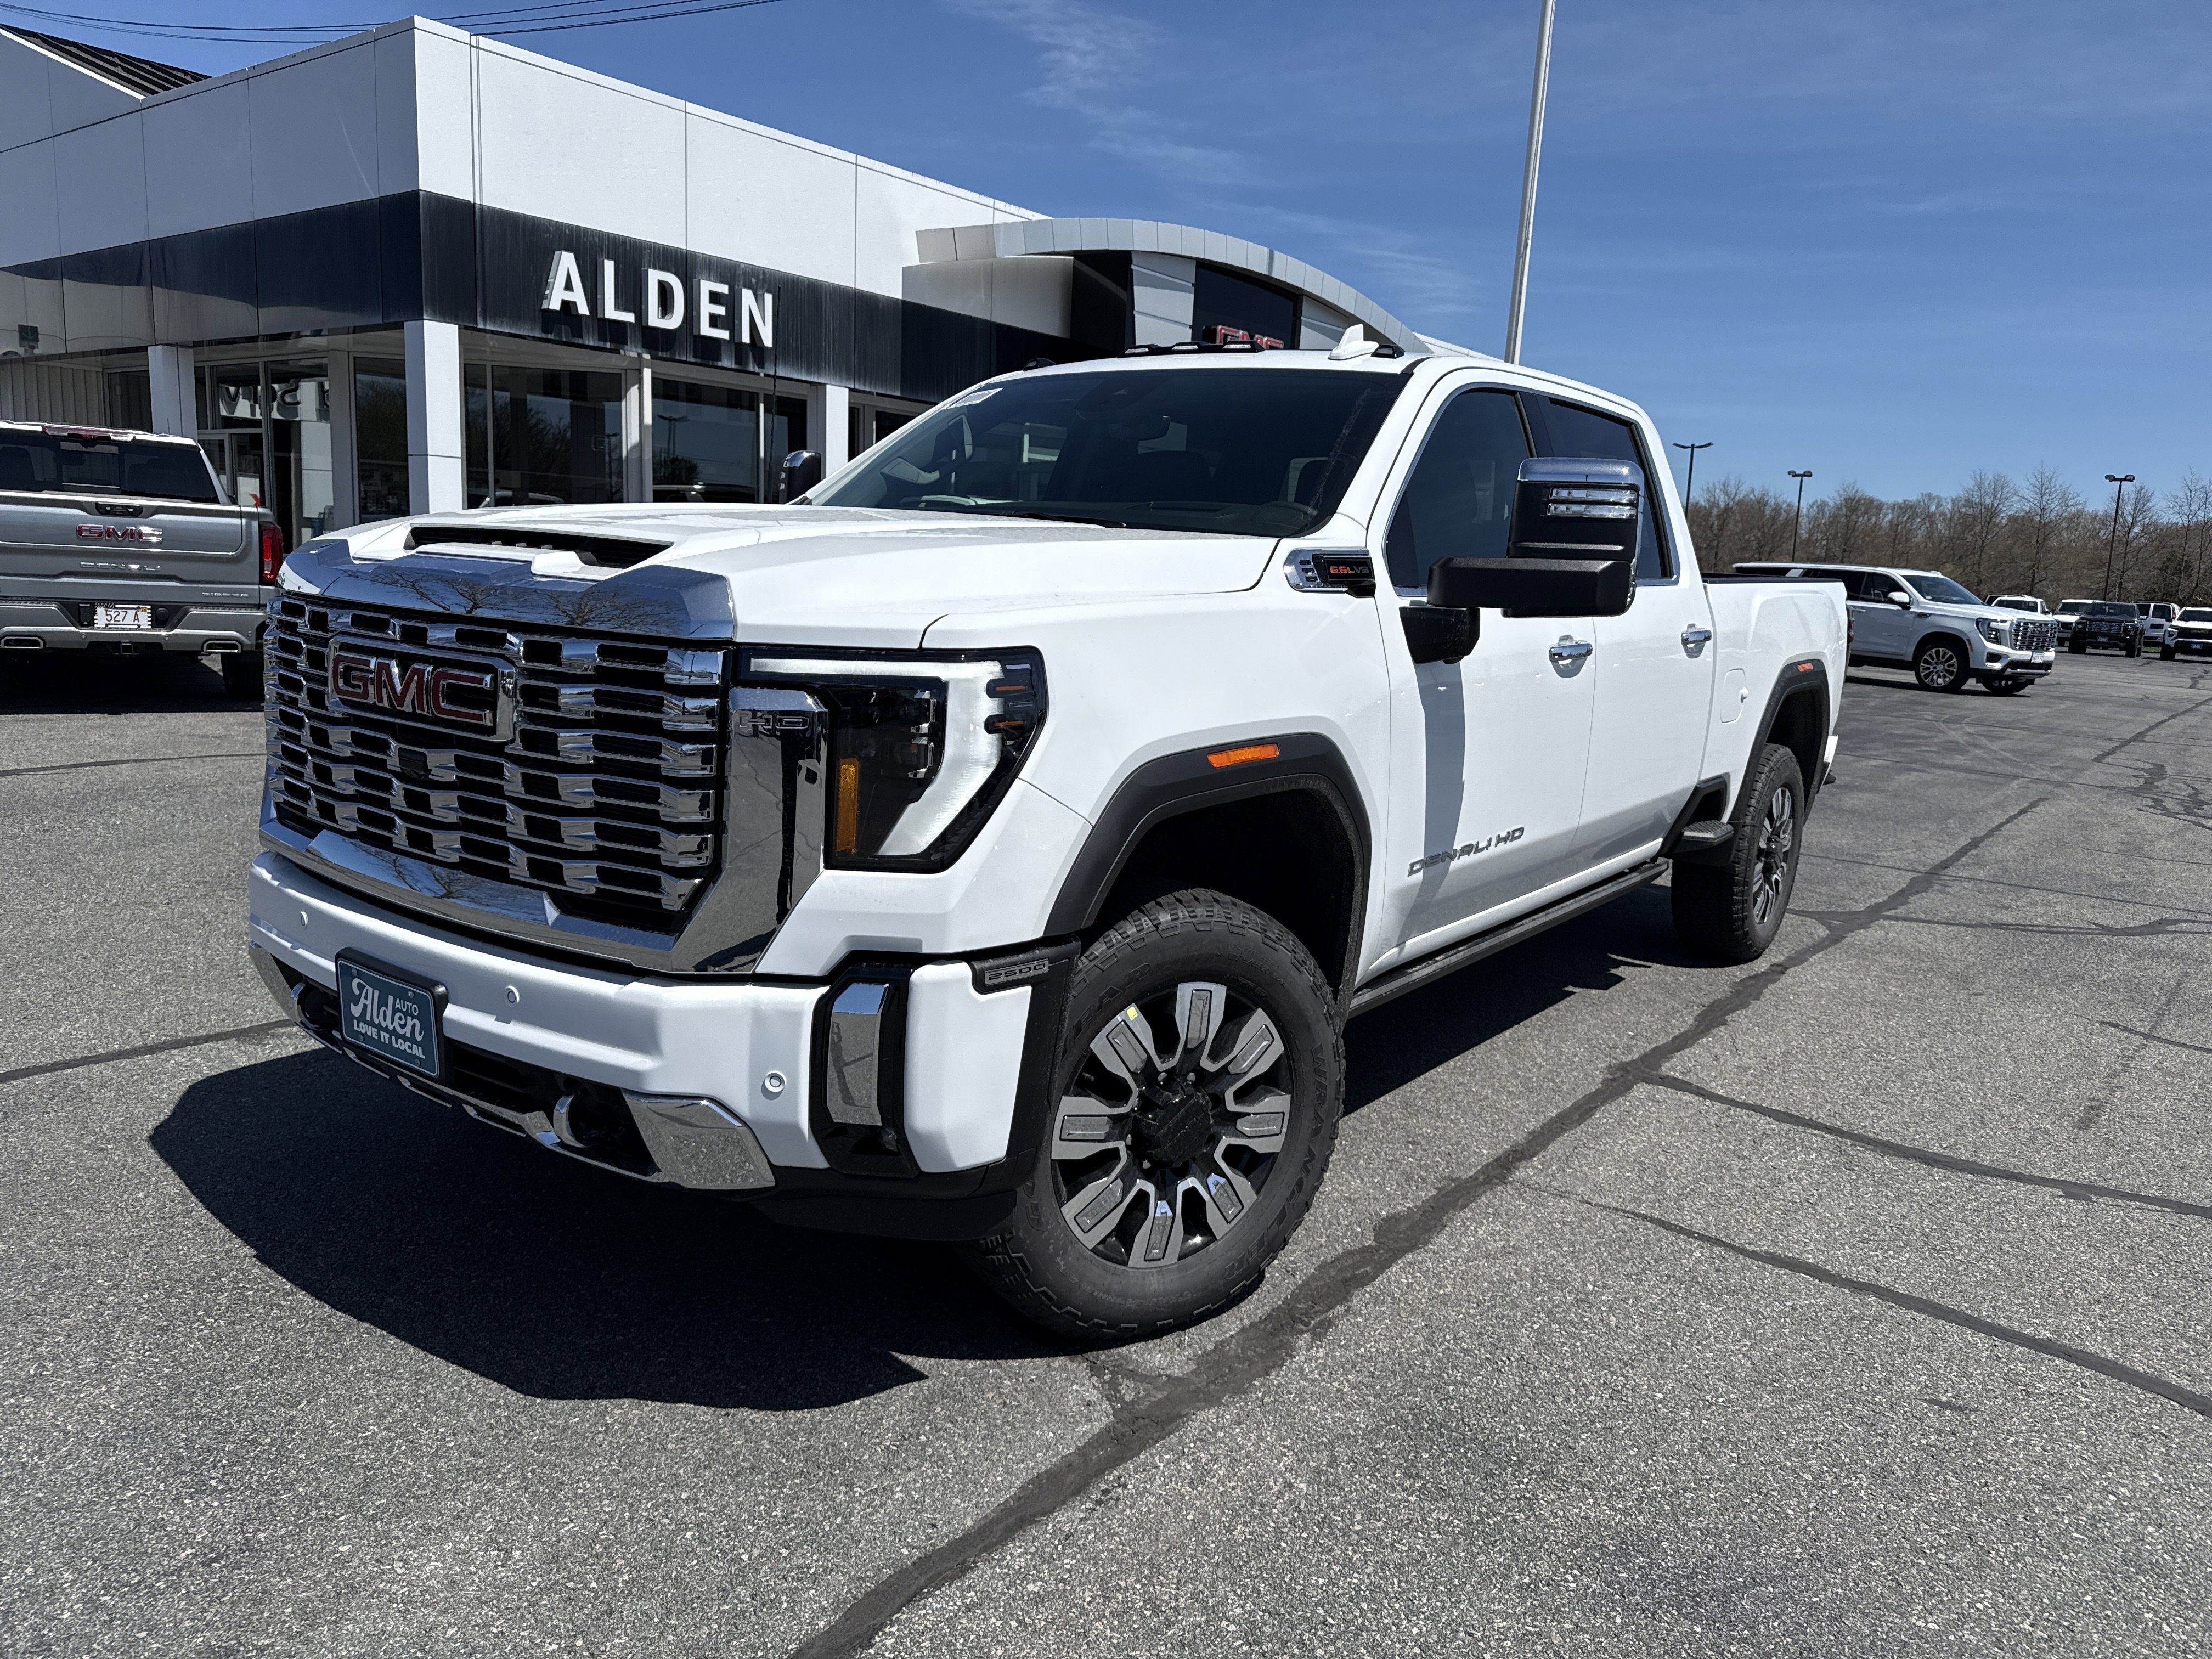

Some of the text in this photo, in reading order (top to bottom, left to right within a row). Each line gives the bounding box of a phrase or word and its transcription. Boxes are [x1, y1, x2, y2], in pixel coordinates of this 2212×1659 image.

[541, 250, 774, 348] ALDEN
[76, 523, 163, 543] GMC
[105, 610, 128, 623] 527
[332, 651, 495, 727] GMC
[1407, 826, 1525, 877] DENALI HD
[988, 963, 1046, 980] 2500
[350, 978, 425, 1041] Alden
[394, 997, 419, 1015] AUTO
[353, 1019, 426, 1059] LOVE IT LOCAL
